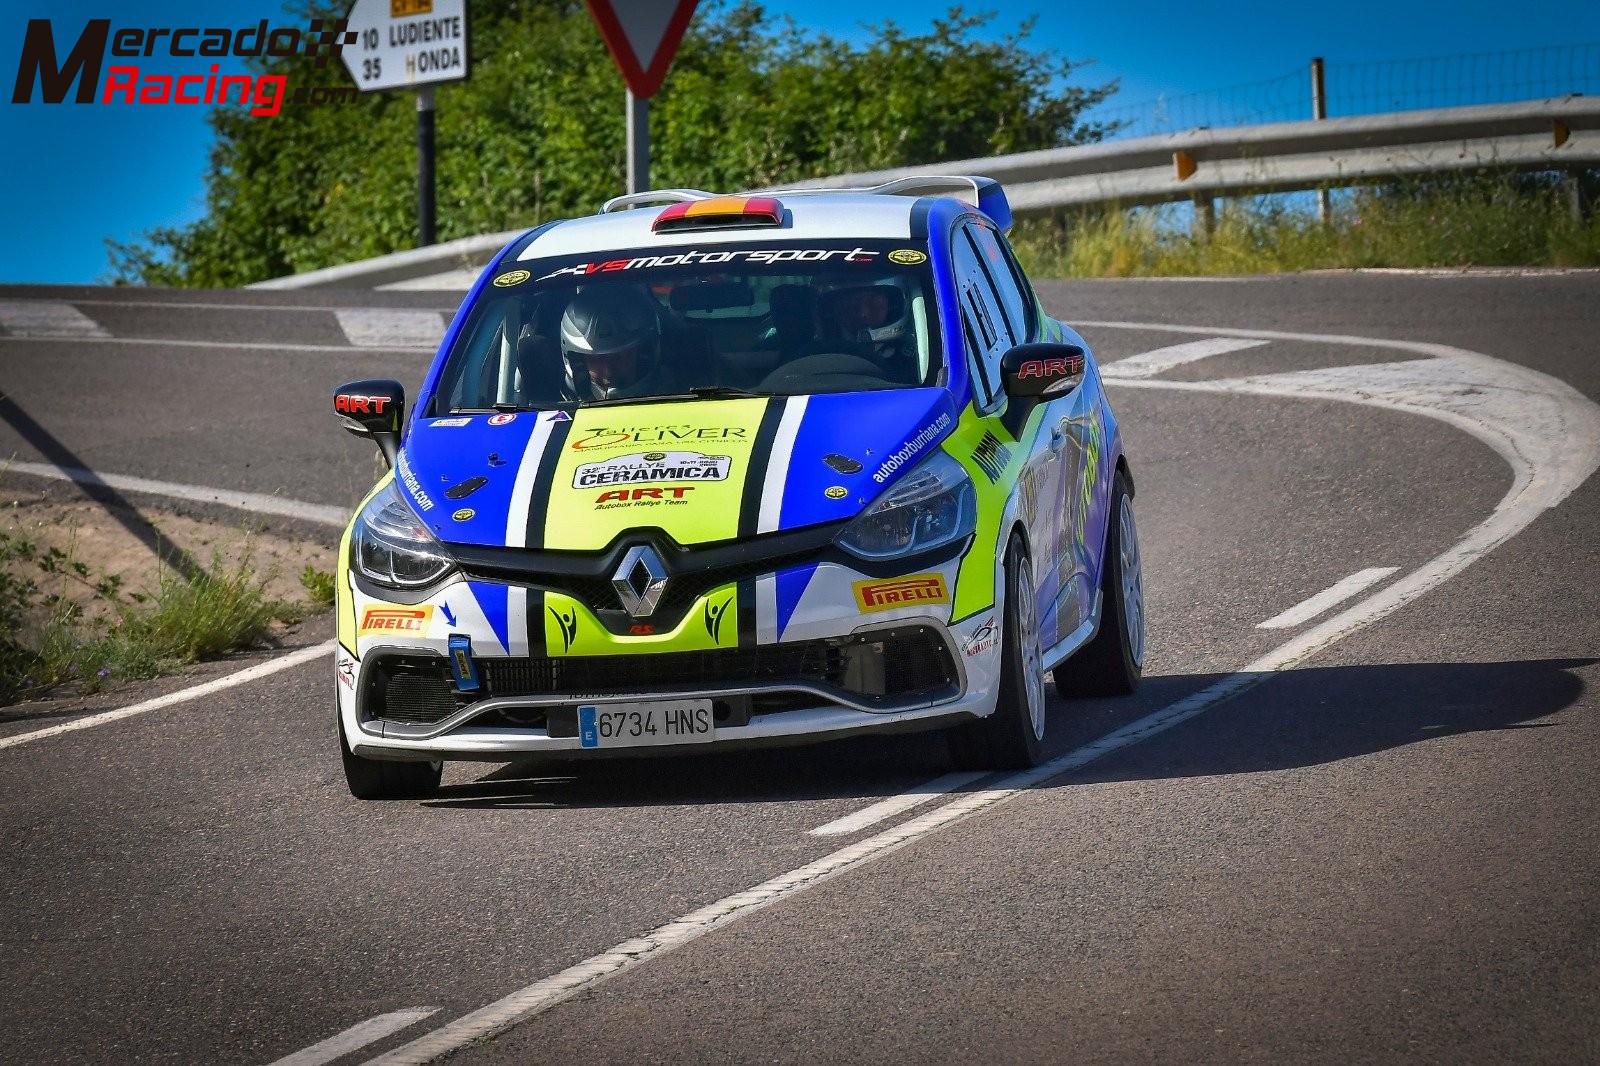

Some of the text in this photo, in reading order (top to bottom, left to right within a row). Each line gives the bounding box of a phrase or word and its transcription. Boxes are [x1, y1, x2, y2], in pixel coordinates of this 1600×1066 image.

[362, 16, 461, 51] 10 LUDIENTE
[362, 57, 382, 80] 35
[1018, 355, 1083, 379] ART
[335, 394, 391, 413] ART
[872, 412, 951, 484] autoboxburriana.com
[607, 462, 666, 472] RALLYE
[397, 447, 434, 511] burriana.com
[594, 501, 632, 510] Autobox
[595, 487, 695, 503] ART
[861, 579, 943, 607] PIRELLI
[362, 609, 426, 631] PIRELLI
[600, 708, 709, 738] 6734 HNS
[585, 731, 593, 740] E
